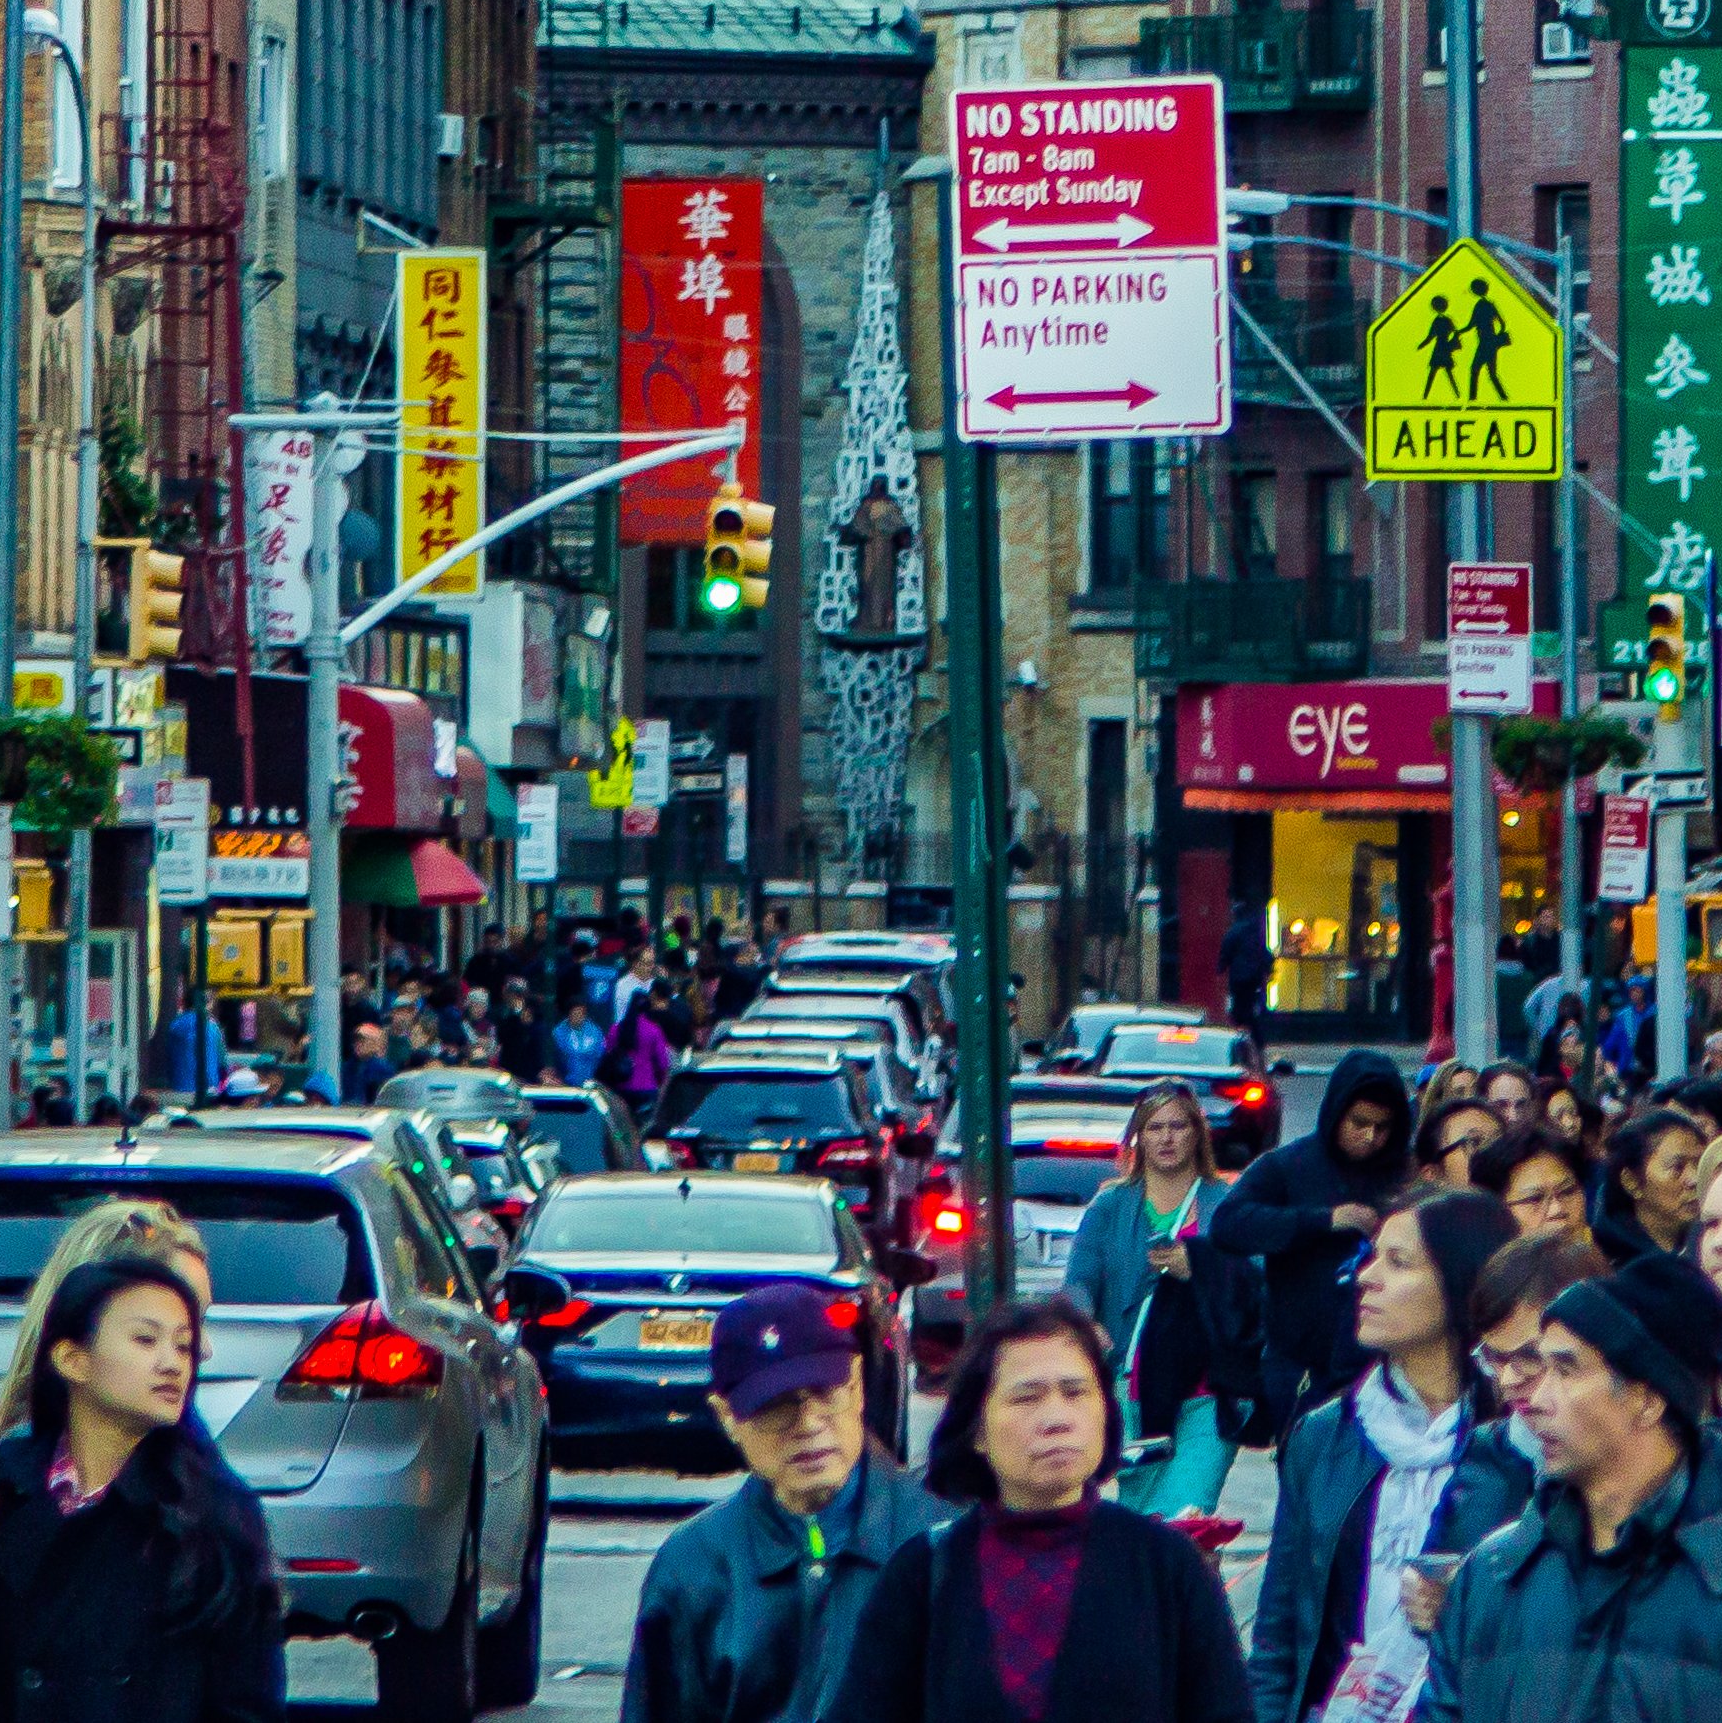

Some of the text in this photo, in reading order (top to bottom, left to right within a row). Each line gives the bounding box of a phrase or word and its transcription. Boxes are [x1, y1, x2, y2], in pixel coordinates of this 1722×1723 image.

[966, 96, 1178, 138] NO STANDING
[969, 146, 1020, 176] 7am
[1041, 145, 1096, 173] 8am
[968, 175, 1144, 212] Except Sunday
[978, 273, 1168, 307] NO PARKING
[979, 318, 1109, 355] Anytime
[1393, 420, 1537, 460] AHEAD
